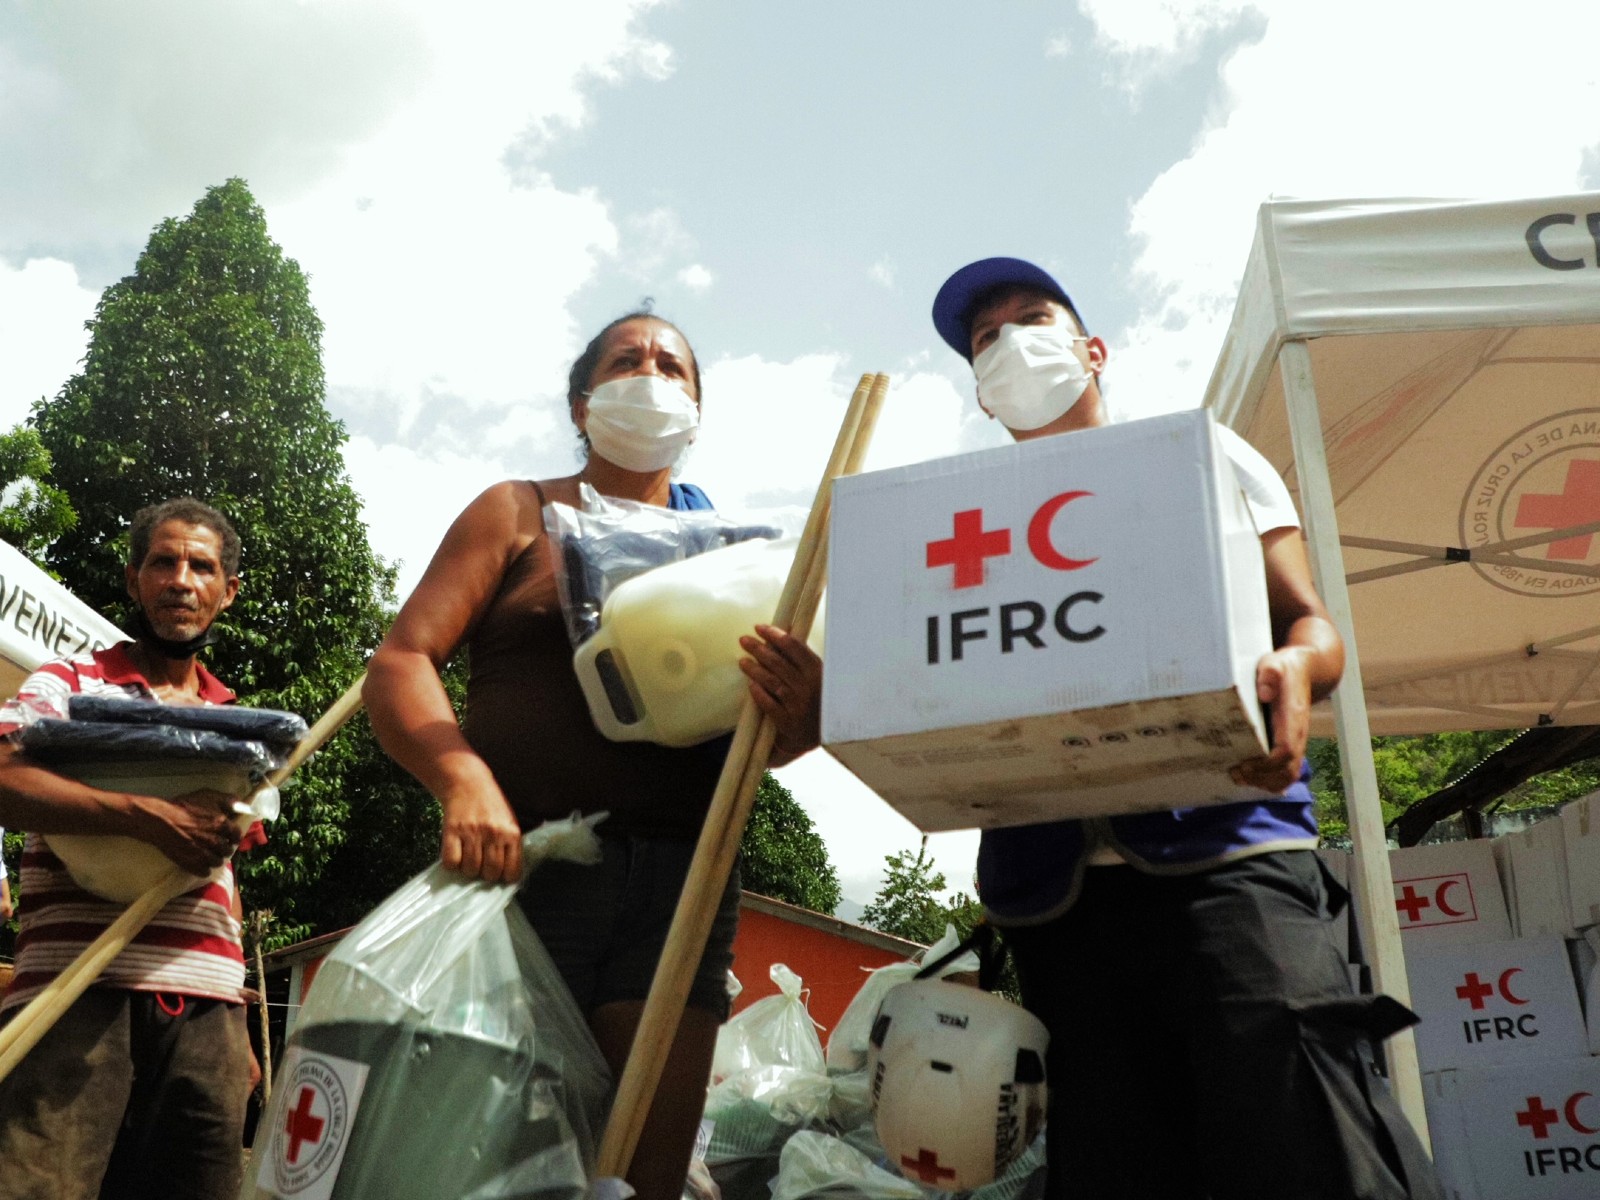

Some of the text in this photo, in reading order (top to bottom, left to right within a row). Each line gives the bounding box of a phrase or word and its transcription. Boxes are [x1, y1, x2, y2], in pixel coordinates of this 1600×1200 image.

[927, 590, 1107, 665] IFRC
[1463, 1013, 1540, 1043] IFRC
[1524, 1144, 1600, 1177] IFRC
